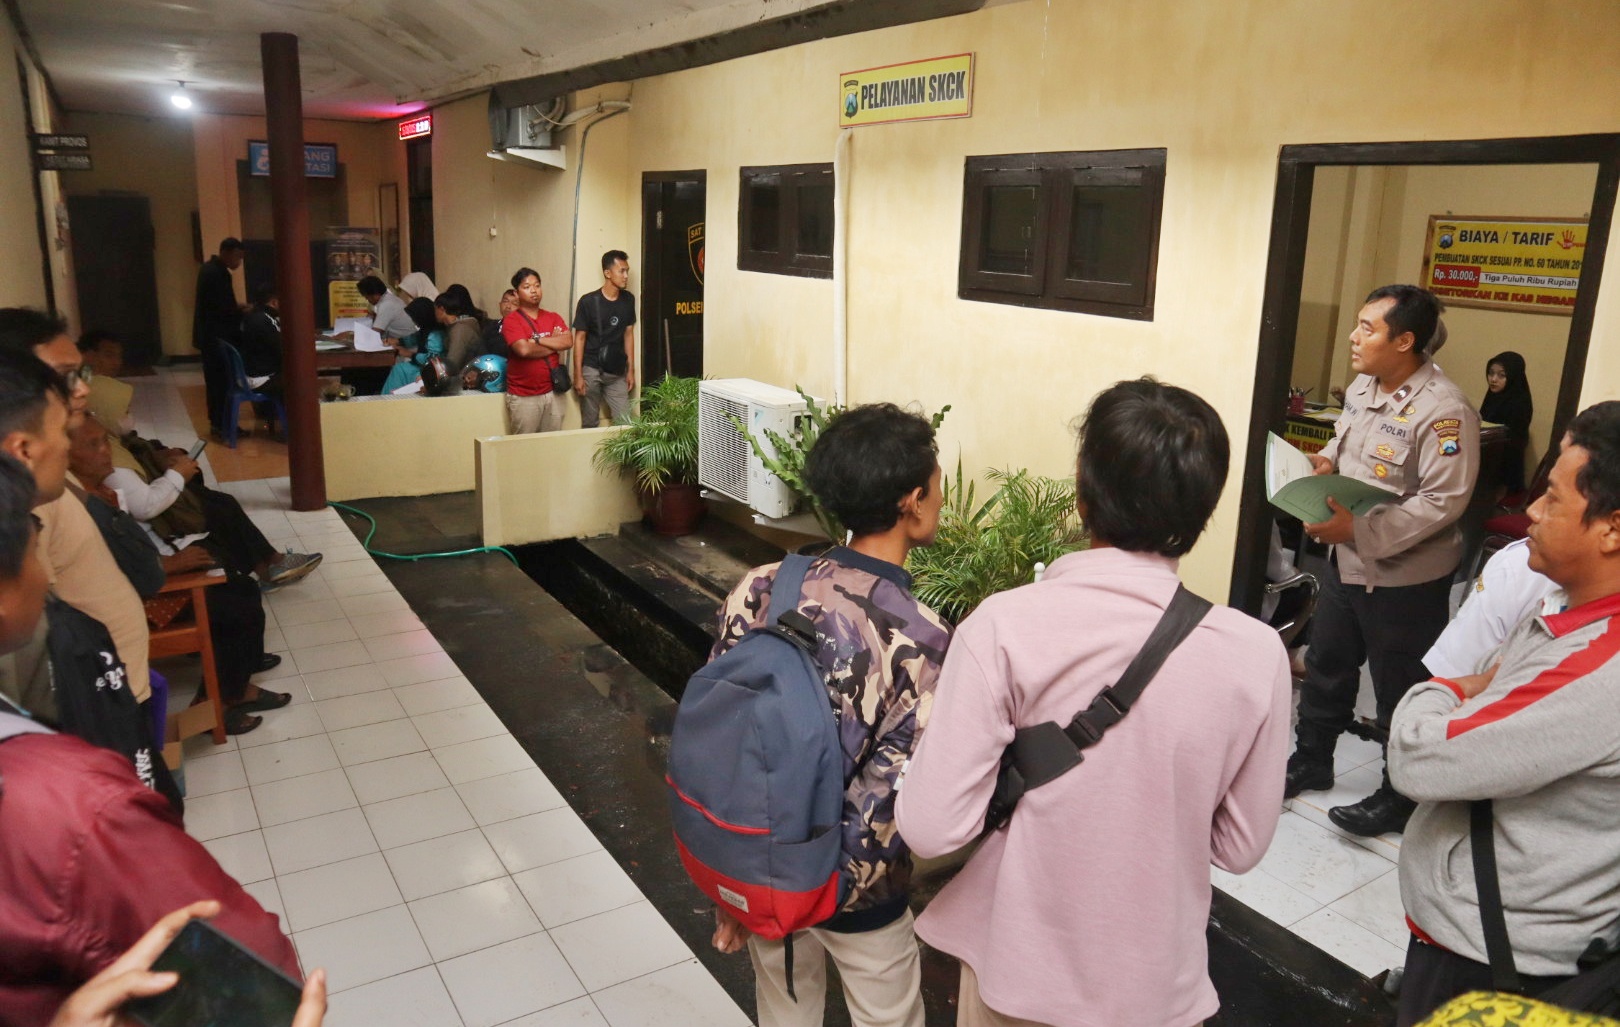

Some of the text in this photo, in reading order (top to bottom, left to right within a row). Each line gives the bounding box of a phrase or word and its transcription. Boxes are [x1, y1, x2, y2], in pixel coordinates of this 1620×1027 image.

[860, 70, 966, 110] PELAYANAN SKCK
[690, 227, 702, 238] SAT
[1459, 229, 1499, 244] BIAYA
[1503, 230, 1509, 244] /
[1511, 231, 1555, 246] TARIF
[1434, 252, 1470, 264] PEMBUATAN
[1471, 254, 1488, 265] SKCK
[1489, 255, 1513, 266] SESUAI
[1524, 257, 1535, 268] NO.
[1546, 258, 1571, 269] TAHUN
[1434, 268, 1479, 283] Rp. 30.000,-
[1484, 273, 1577, 289] Tiga Puluh Ribu Rupiah
[1380, 423, 1407, 439] POLRI
